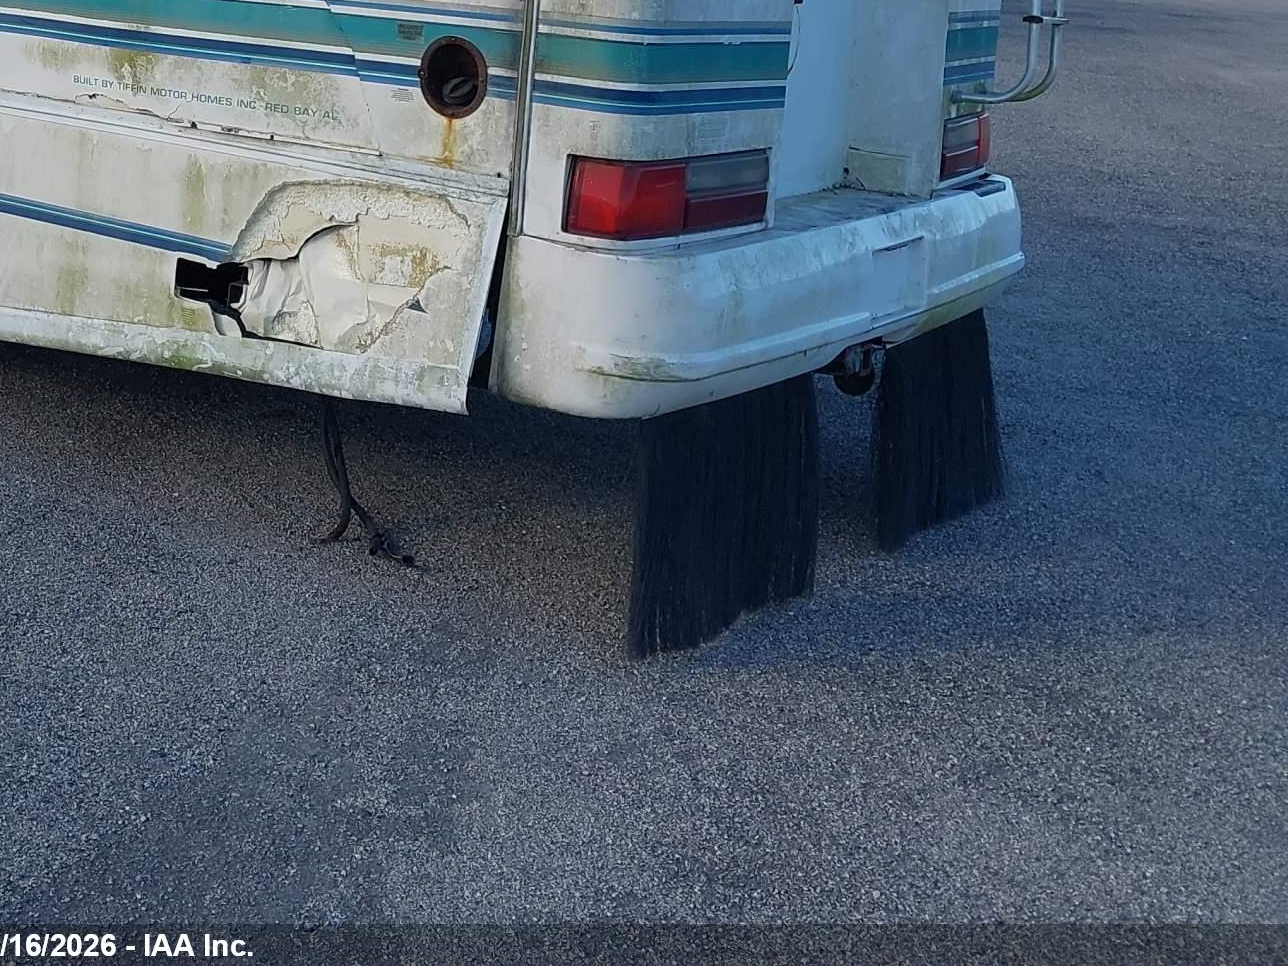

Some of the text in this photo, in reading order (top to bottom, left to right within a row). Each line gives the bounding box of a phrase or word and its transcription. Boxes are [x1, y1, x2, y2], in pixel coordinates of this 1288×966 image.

[73, 74, 99, 87] BUILT
[101, 79, 114, 89] BY
[116, 81, 147, 95] TIFFIN
[150, 86, 188, 101] MOTOR
[191, 92, 233, 107] HOMES
[293, 106, 318, 118] BAY
